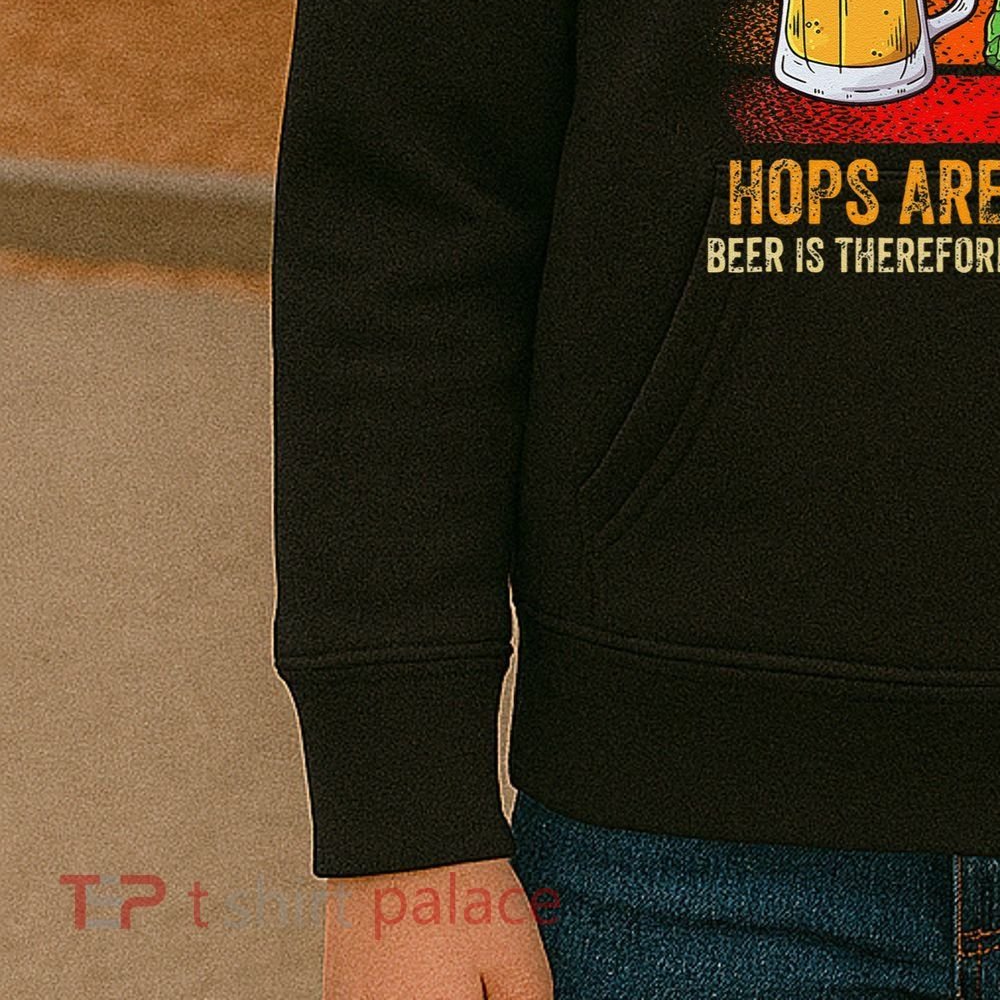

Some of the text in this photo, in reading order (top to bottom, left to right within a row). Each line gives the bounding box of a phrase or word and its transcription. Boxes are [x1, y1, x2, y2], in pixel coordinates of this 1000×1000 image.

[730, 158, 879, 225] HOPS
[707, 237, 784, 273] BEER
[796, 237, 825, 273] IS
